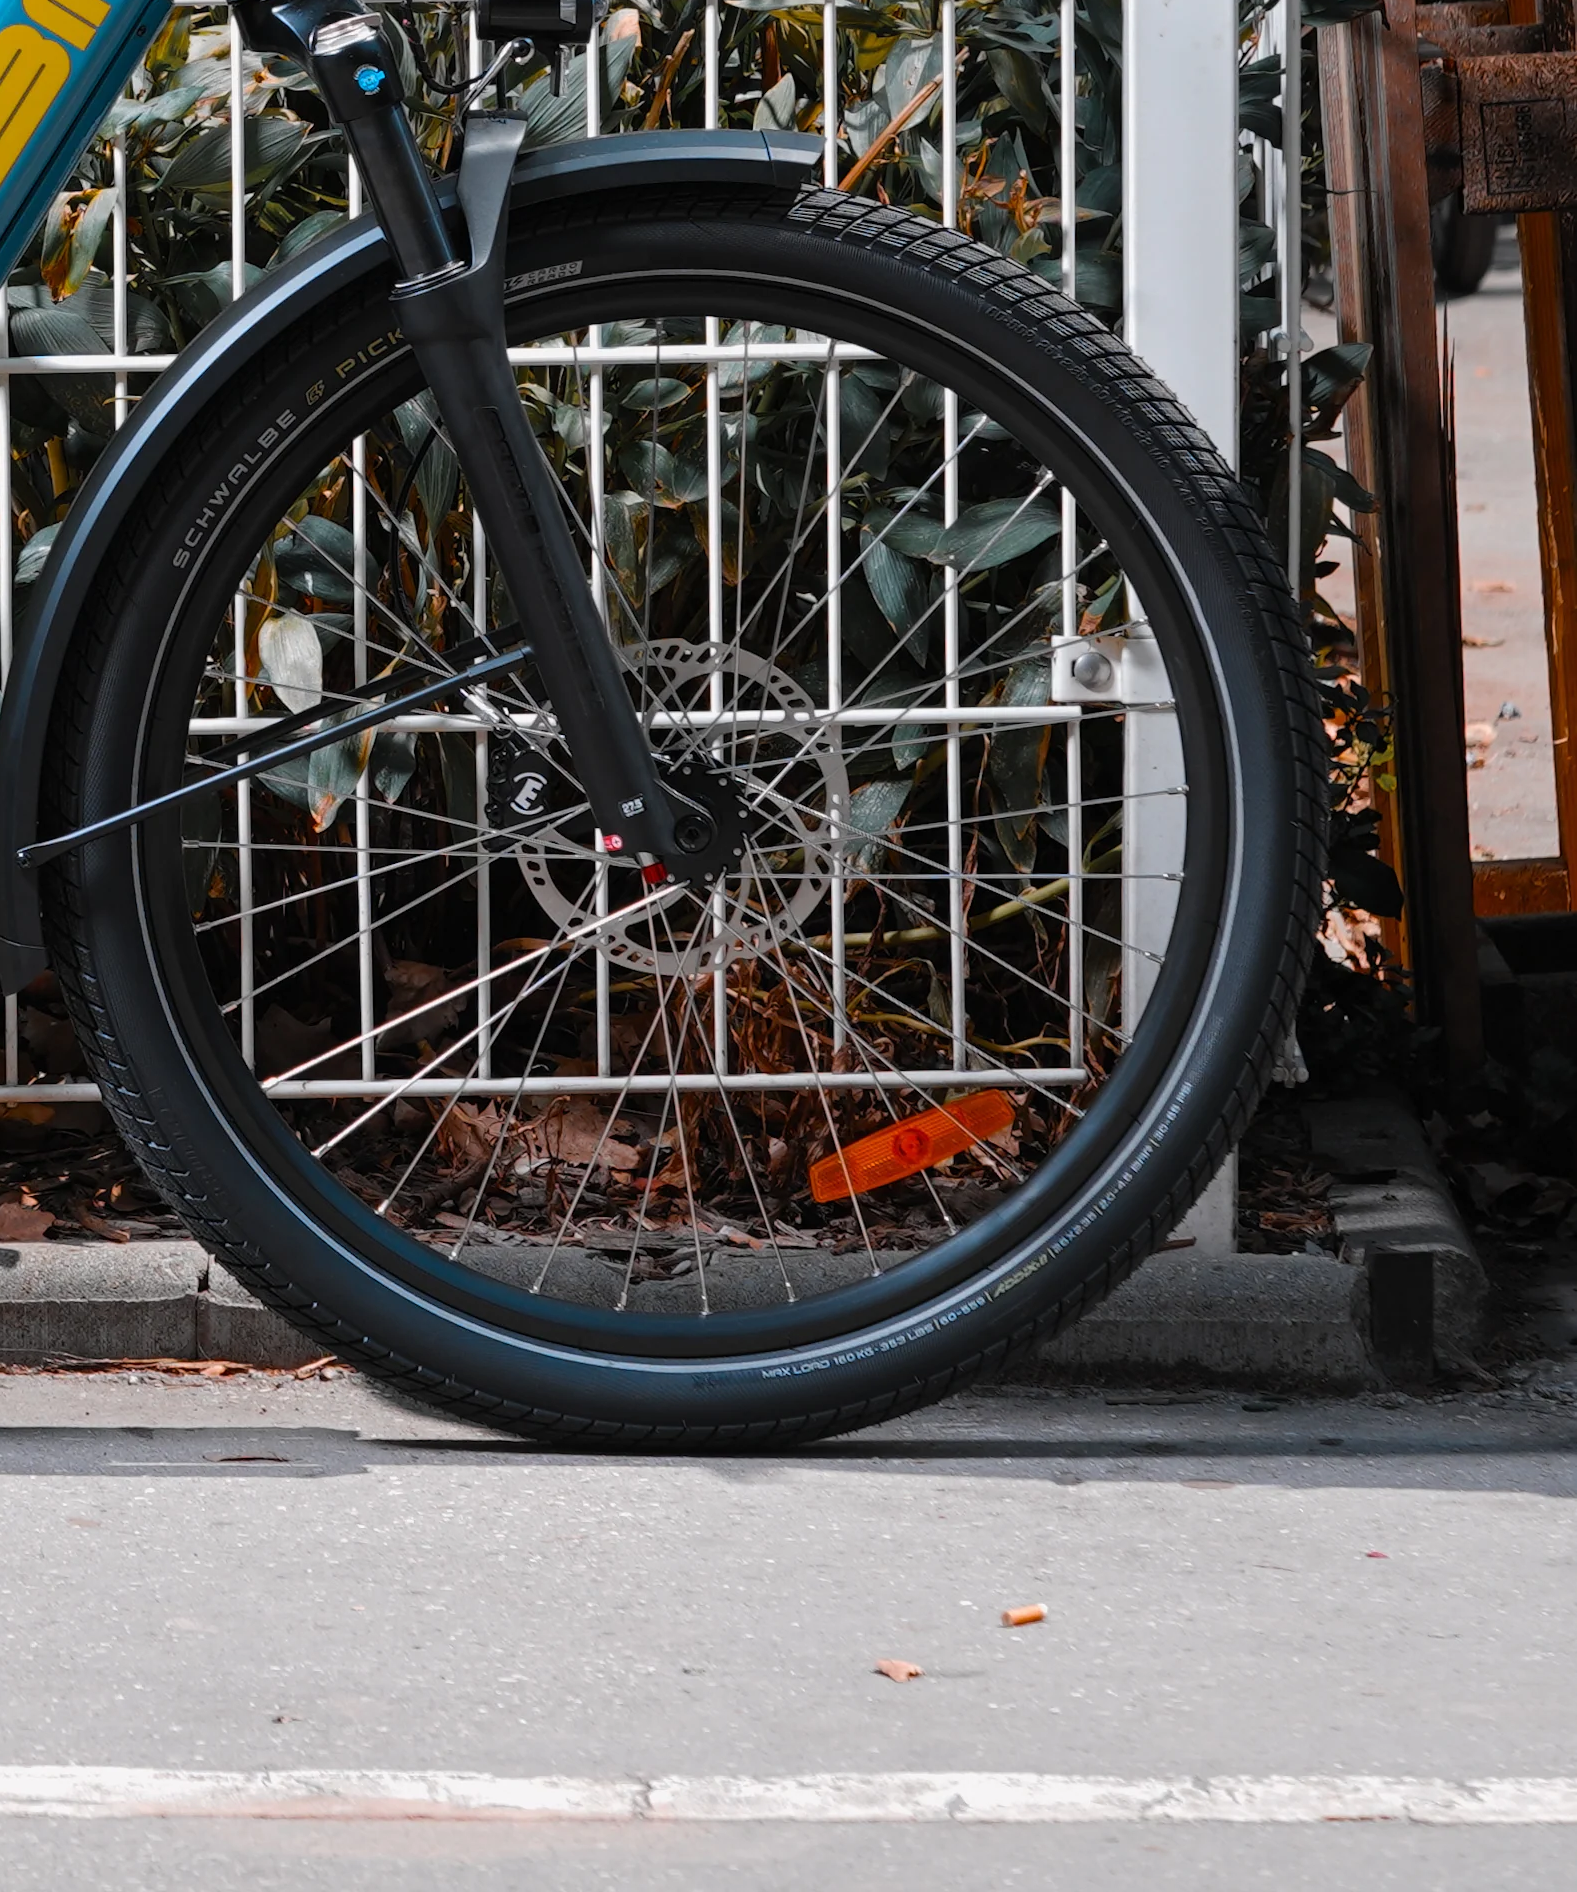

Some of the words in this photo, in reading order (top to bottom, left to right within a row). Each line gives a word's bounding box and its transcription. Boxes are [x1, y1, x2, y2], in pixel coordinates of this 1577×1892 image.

[525, 266, 578, 286] READY
[526, 260, 579, 280] CARGO
[172, 408, 297, 570] SCHWALBE
[335, 327, 406, 379] PICK
[760, 1365, 792, 1380] MAX
[791, 1357, 831, 1376] LOAD
